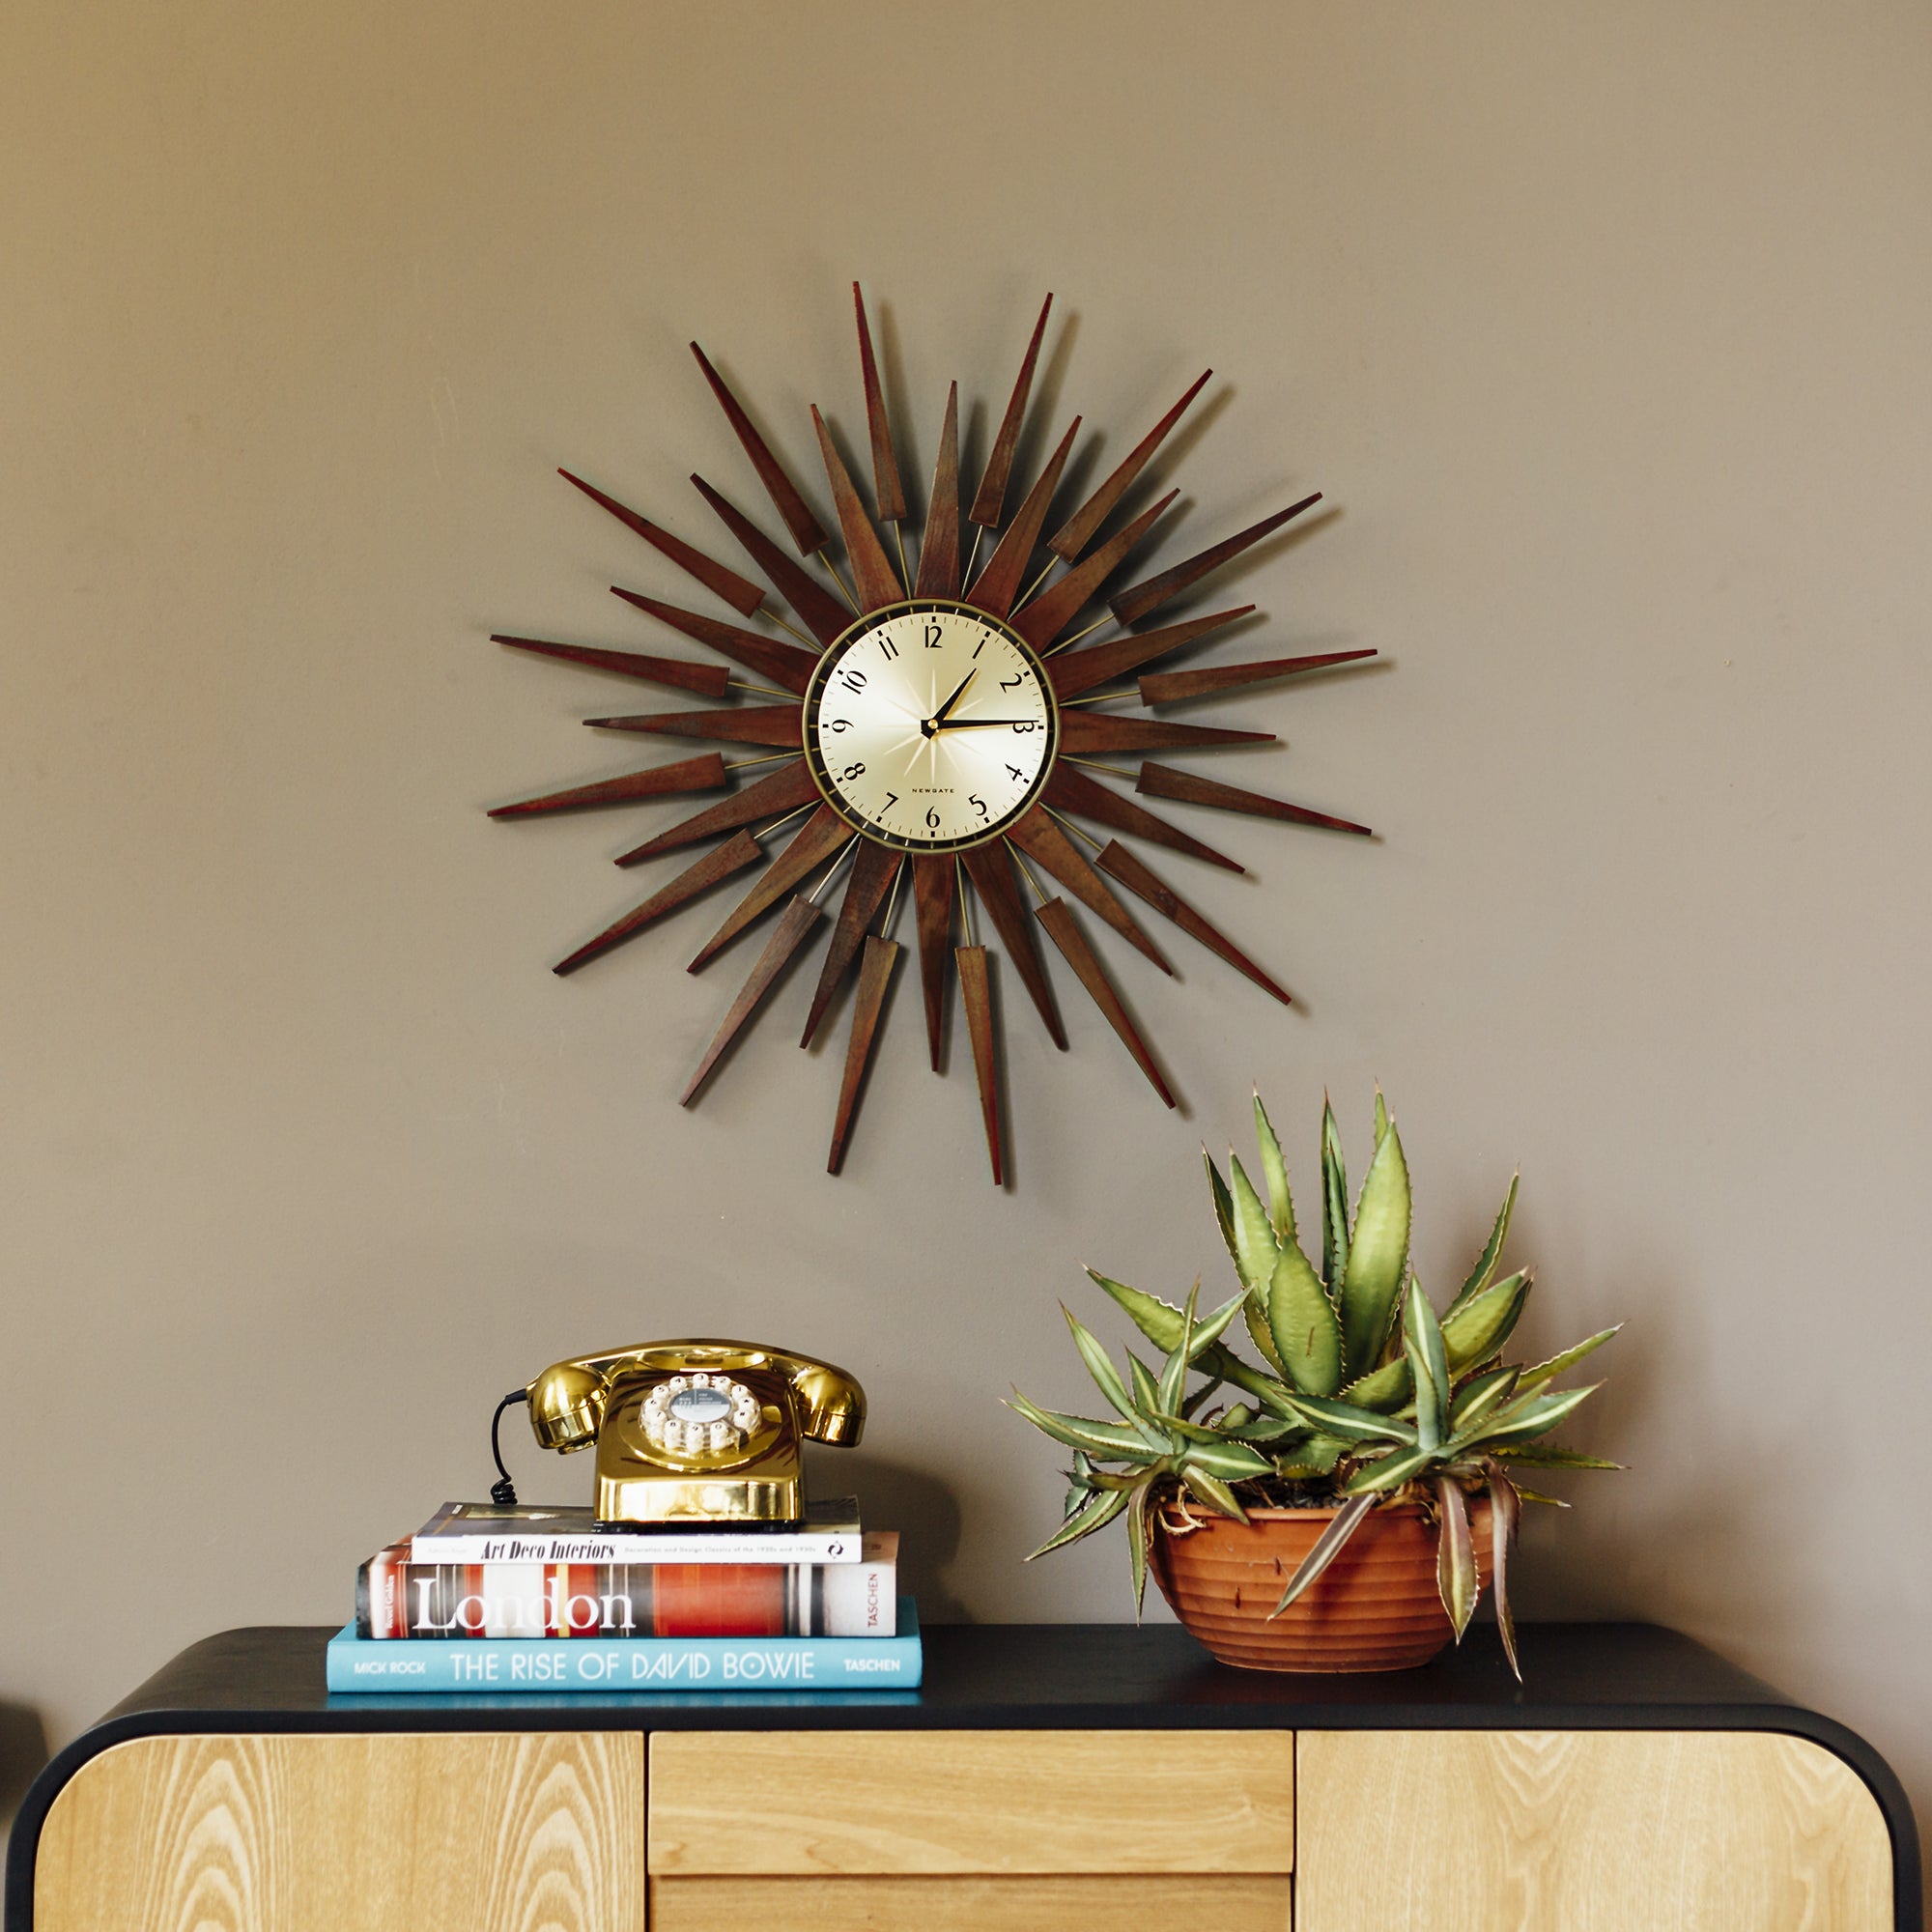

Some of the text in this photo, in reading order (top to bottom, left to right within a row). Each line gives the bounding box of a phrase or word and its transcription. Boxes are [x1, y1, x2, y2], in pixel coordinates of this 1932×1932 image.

[924, 625, 943, 649] 12
[878, 636, 899, 661] 11
[972, 639, 985, 660] 1
[841, 669, 867, 695] 10
[999, 672, 1023, 694] 2
[831, 719, 854, 733] 9
[1012, 720, 1035, 734] 3
[843, 762, 866, 781] 8
[1005, 763, 1023, 781] 4
[881, 791, 899, 814] 7
[968, 793, 987, 816] 5
[925, 806, 941, 829] 6
[481, 1541, 506, 1559] Art
[508, 1541, 546, 1559] Deco
[550, 1540, 616, 1559] Interiors
[412, 1577, 638, 1631] London
[867, 1574, 878, 1628] TASCHEN
[355, 1661, 426, 1675] MICK ROCK
[450, 1652, 815, 1681] THE RISE OF DAVID BOWIE
[843, 1658, 901, 1672] TASCHEN
